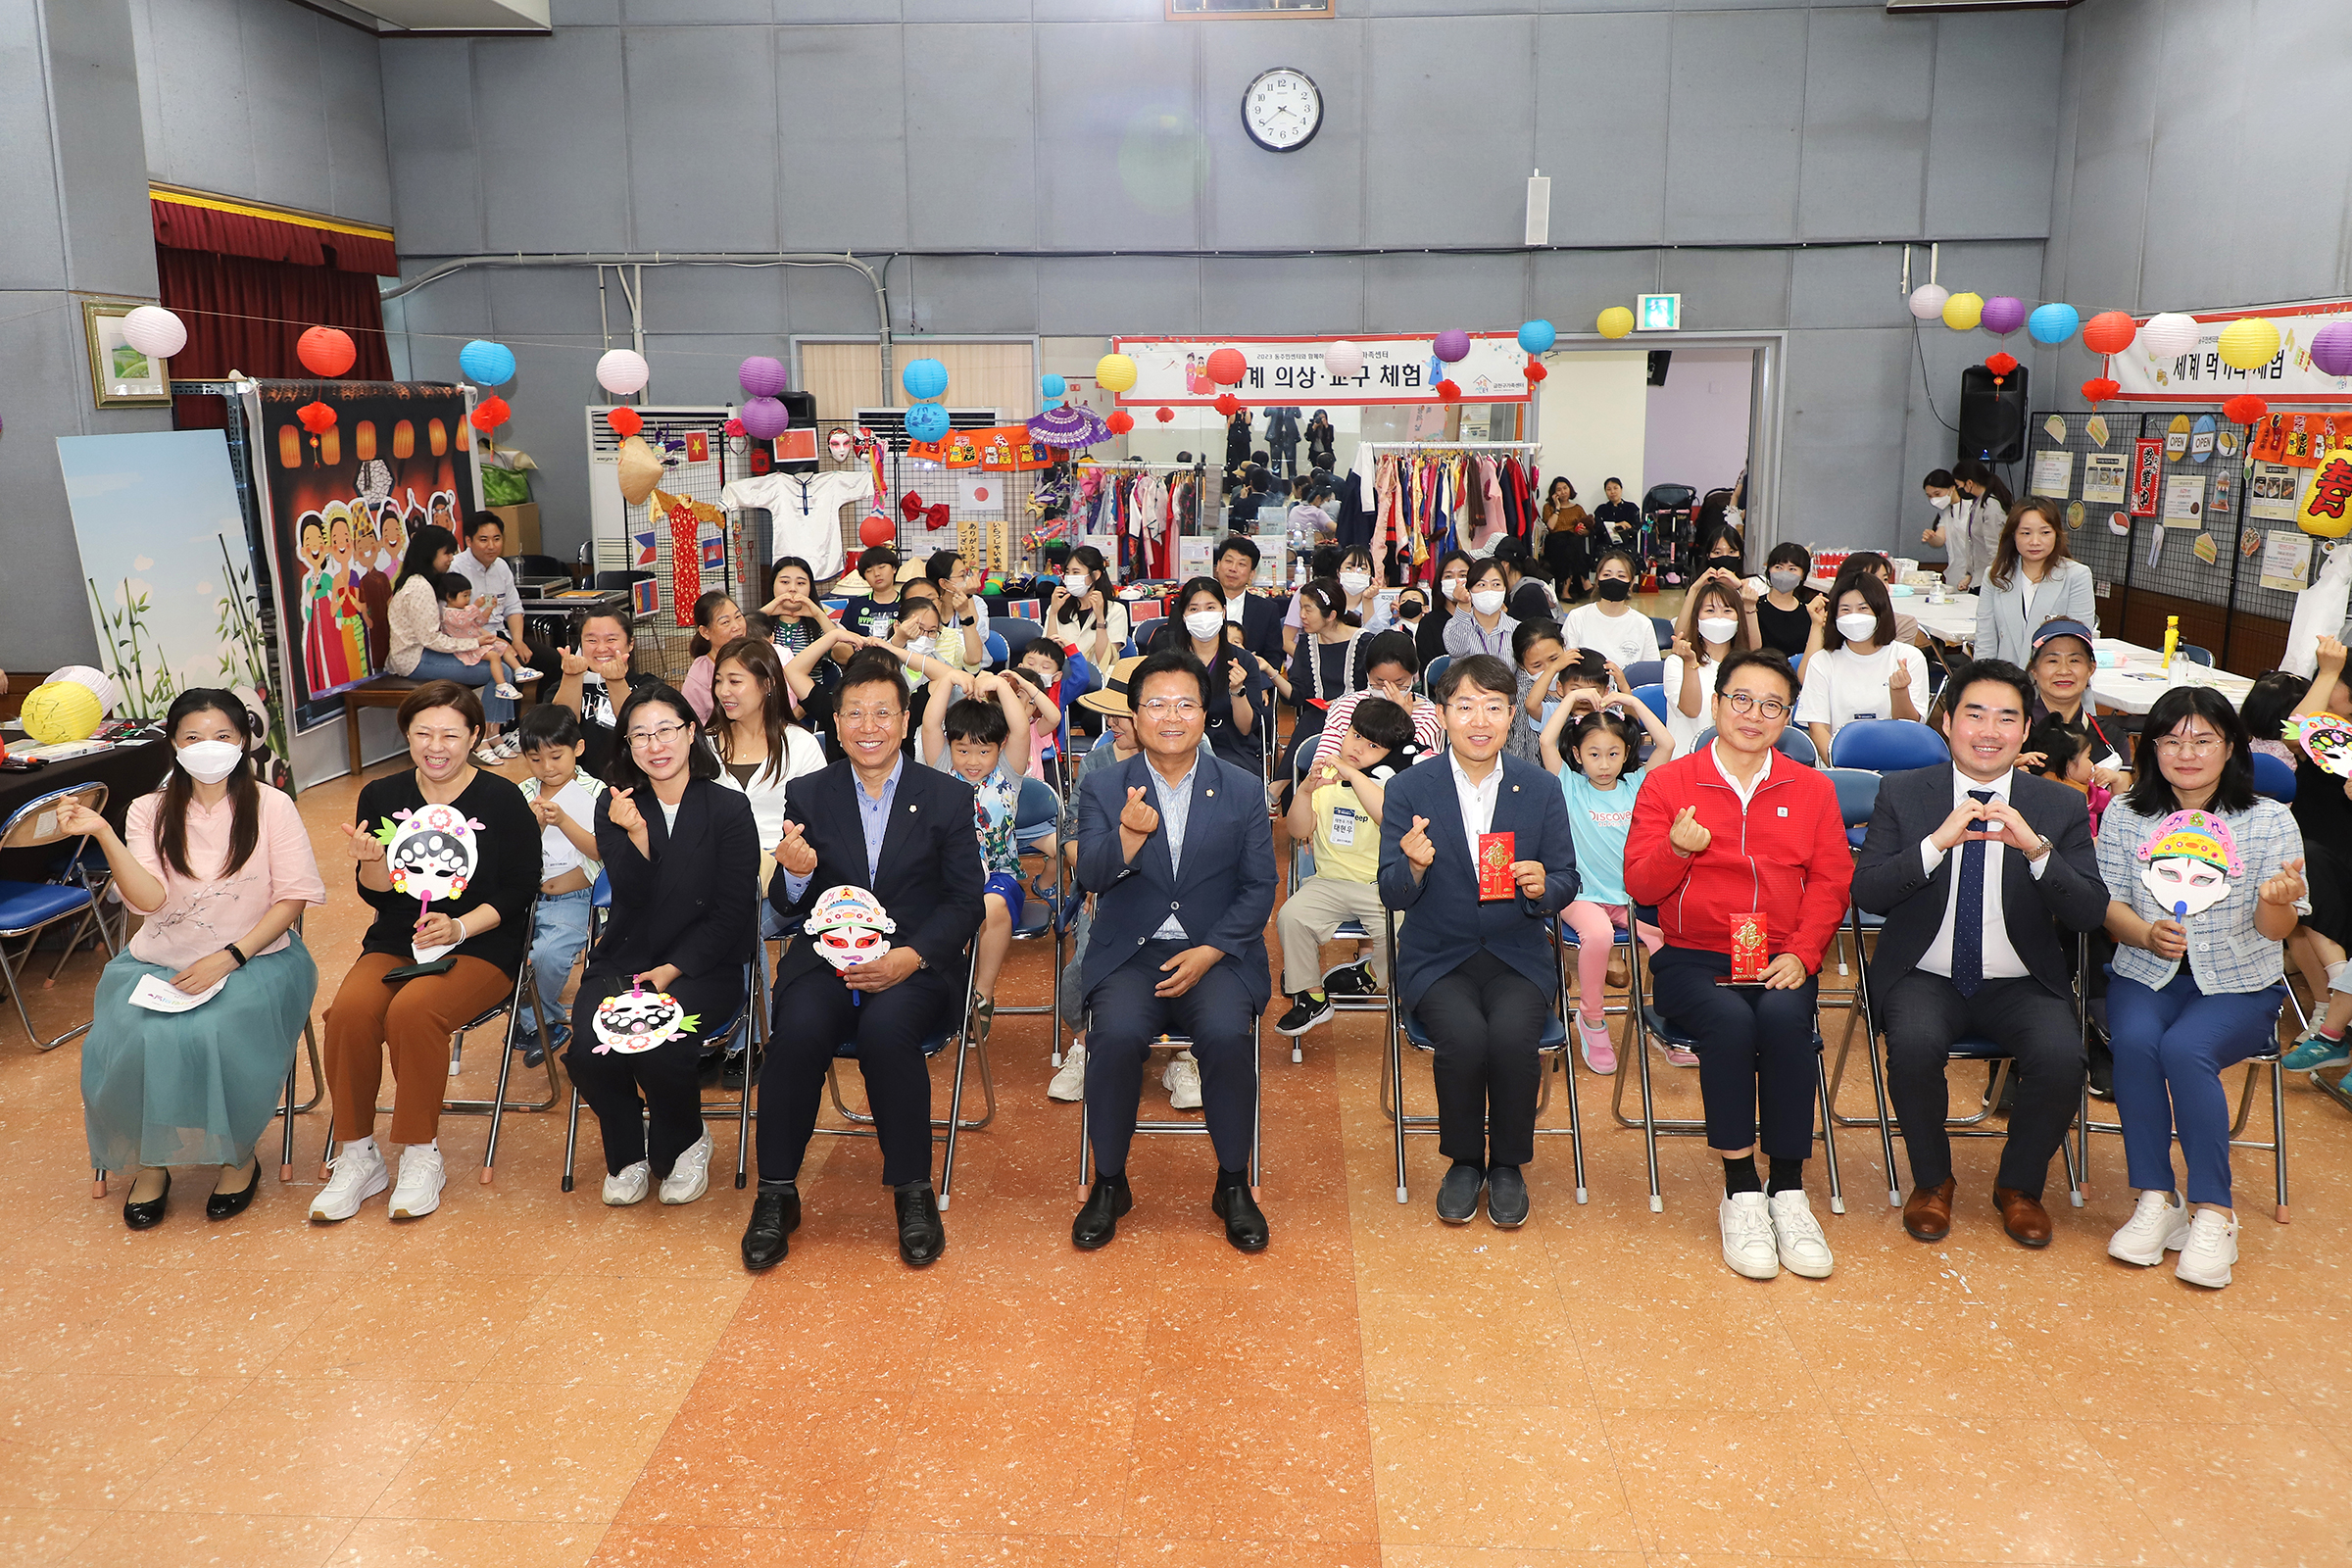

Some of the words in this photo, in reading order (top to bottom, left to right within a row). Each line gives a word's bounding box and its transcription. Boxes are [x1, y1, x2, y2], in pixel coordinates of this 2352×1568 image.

[1279, 130, 1287, 139] 6
[2173, 353, 2201, 380] 세계
[1379, 364, 1422, 388] 체험
[2169, 436, 2185, 448] OPEN
[2195, 436, 2212, 448] OPEN
[968, 522, 977, 560] ありがとう
[1354, 814, 1369, 823] eep
